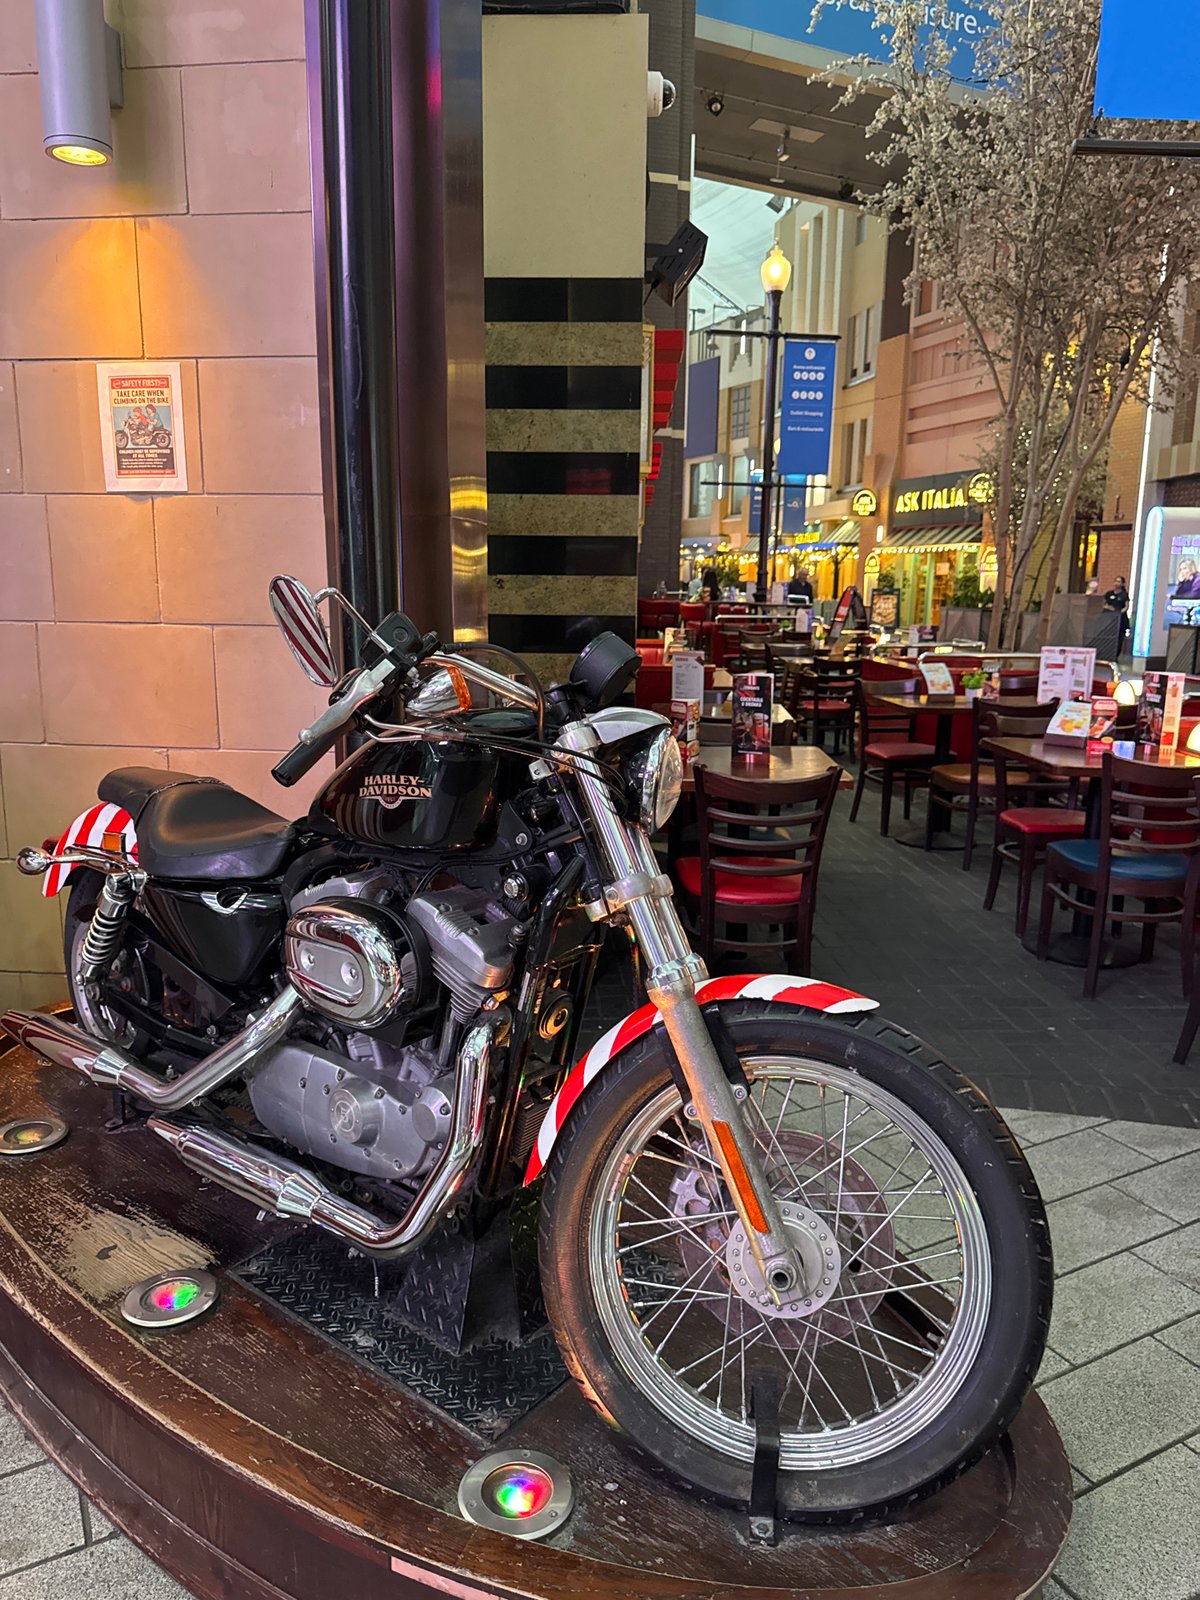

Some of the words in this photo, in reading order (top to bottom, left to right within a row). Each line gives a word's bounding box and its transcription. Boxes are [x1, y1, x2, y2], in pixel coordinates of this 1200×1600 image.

[121, 380, 141, 388] SAFETY
[146, 389, 164, 397] WHEN
[113, 397, 138, 405] CLIMBING
[895, 491, 920, 513] ASK
[364, 774, 425, 786] HARLEY-
[359, 785, 432, 798] DAVIDSON
